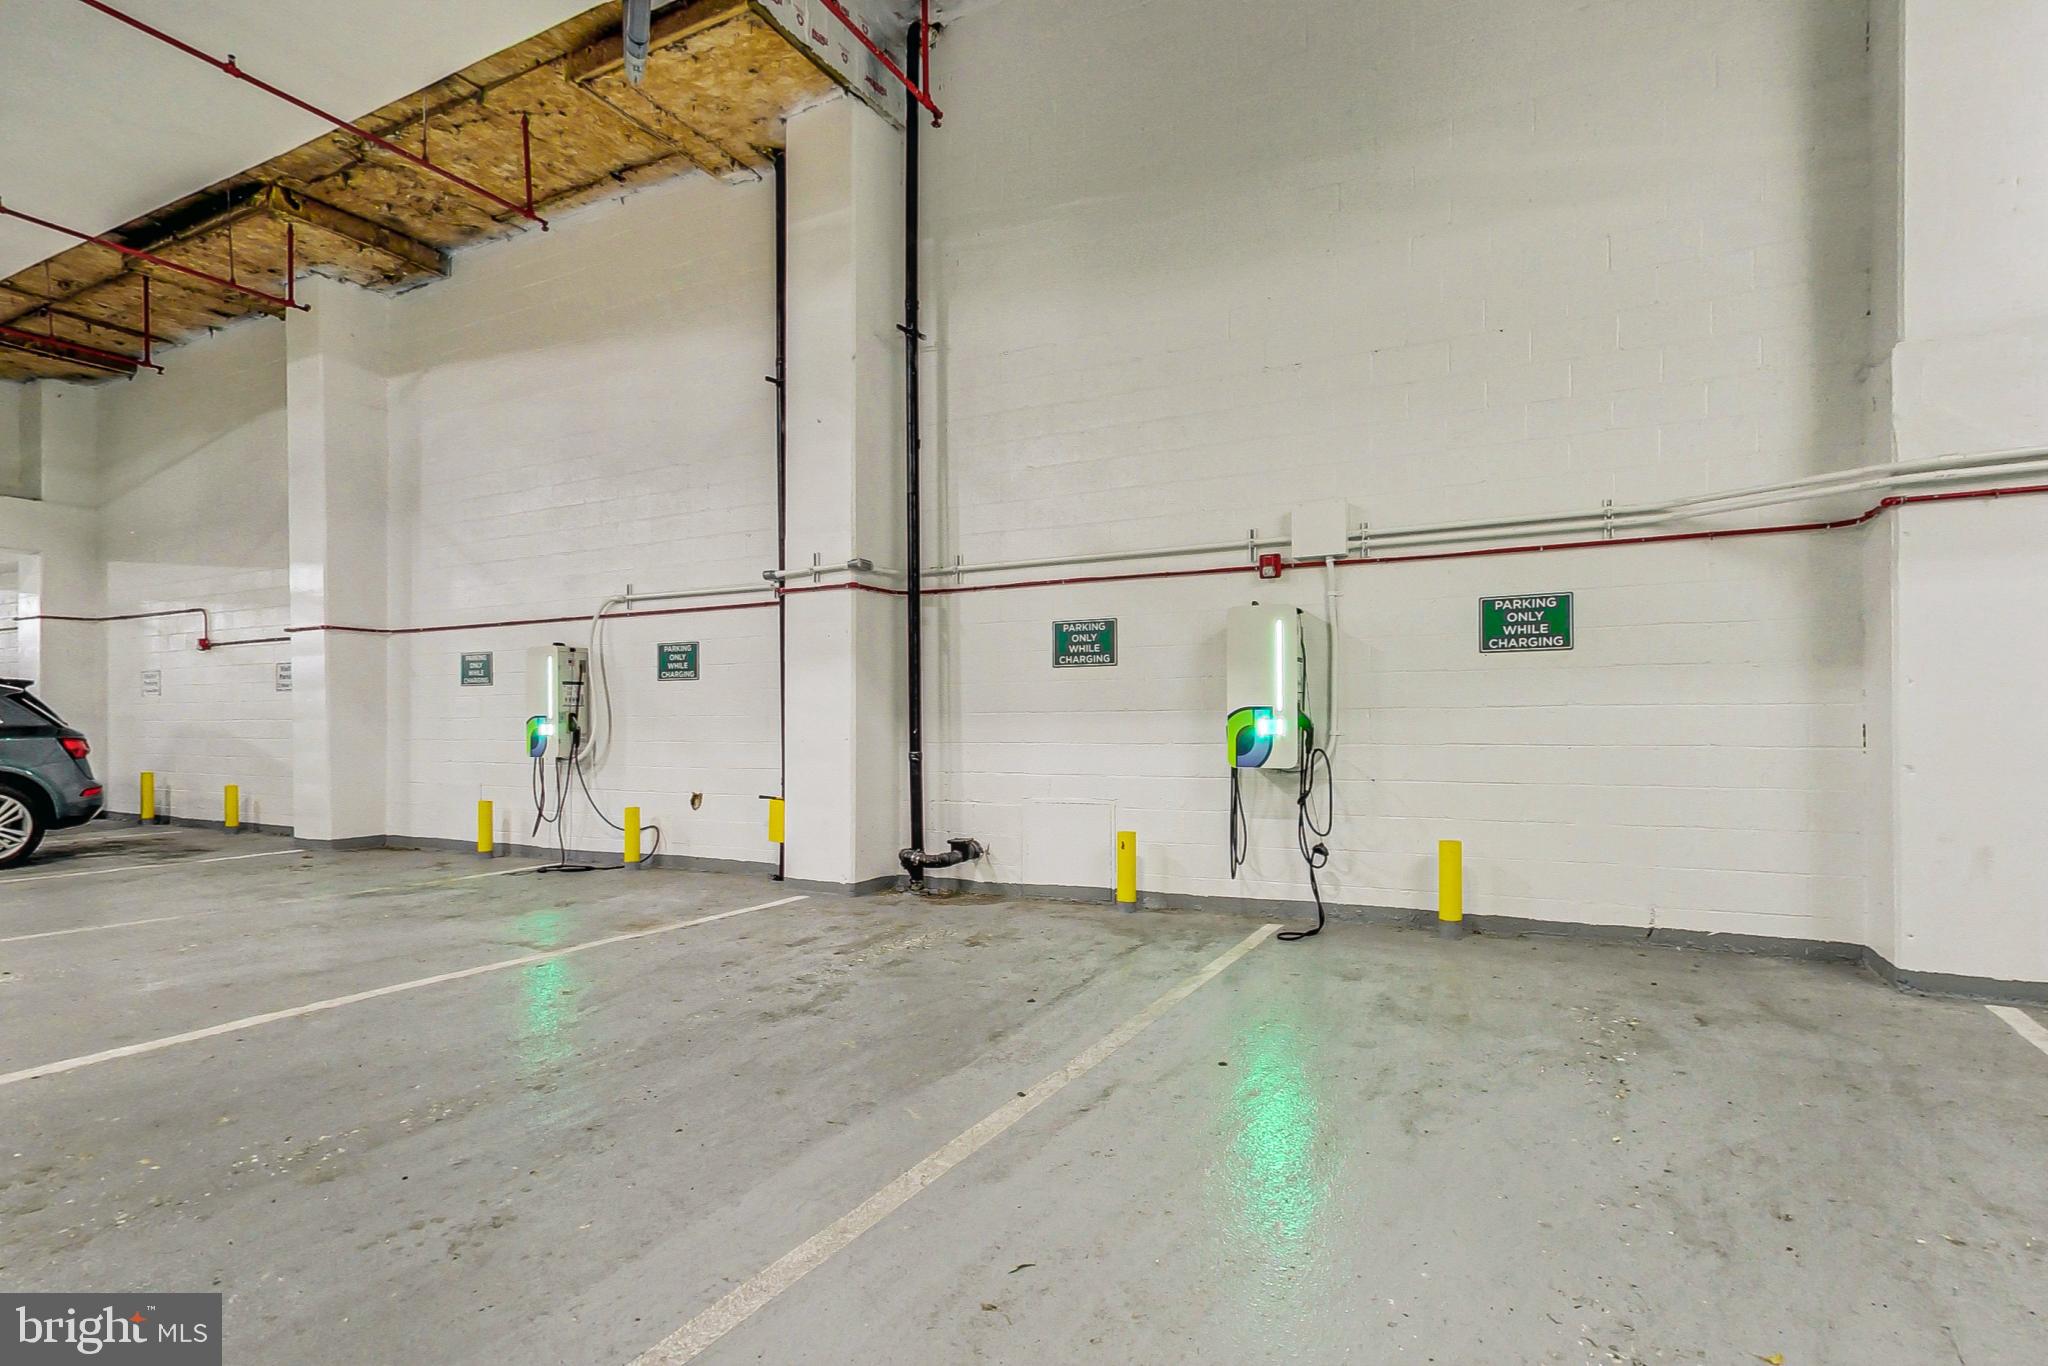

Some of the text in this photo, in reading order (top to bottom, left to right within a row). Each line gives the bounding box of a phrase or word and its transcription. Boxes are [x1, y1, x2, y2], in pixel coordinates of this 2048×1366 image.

[1495, 597, 1557, 610] PARKING
[1506, 611, 1545, 622] ONLY
[1063, 622, 1106, 632] PARKING
[1502, 623, 1549, 635] WHILE
[1071, 633, 1097, 642] ONLY
[1488, 636, 1564, 648] CHARGING
[1068, 644, 1101, 653] WHILE
[1058, 654, 1110, 664] CHARGING
